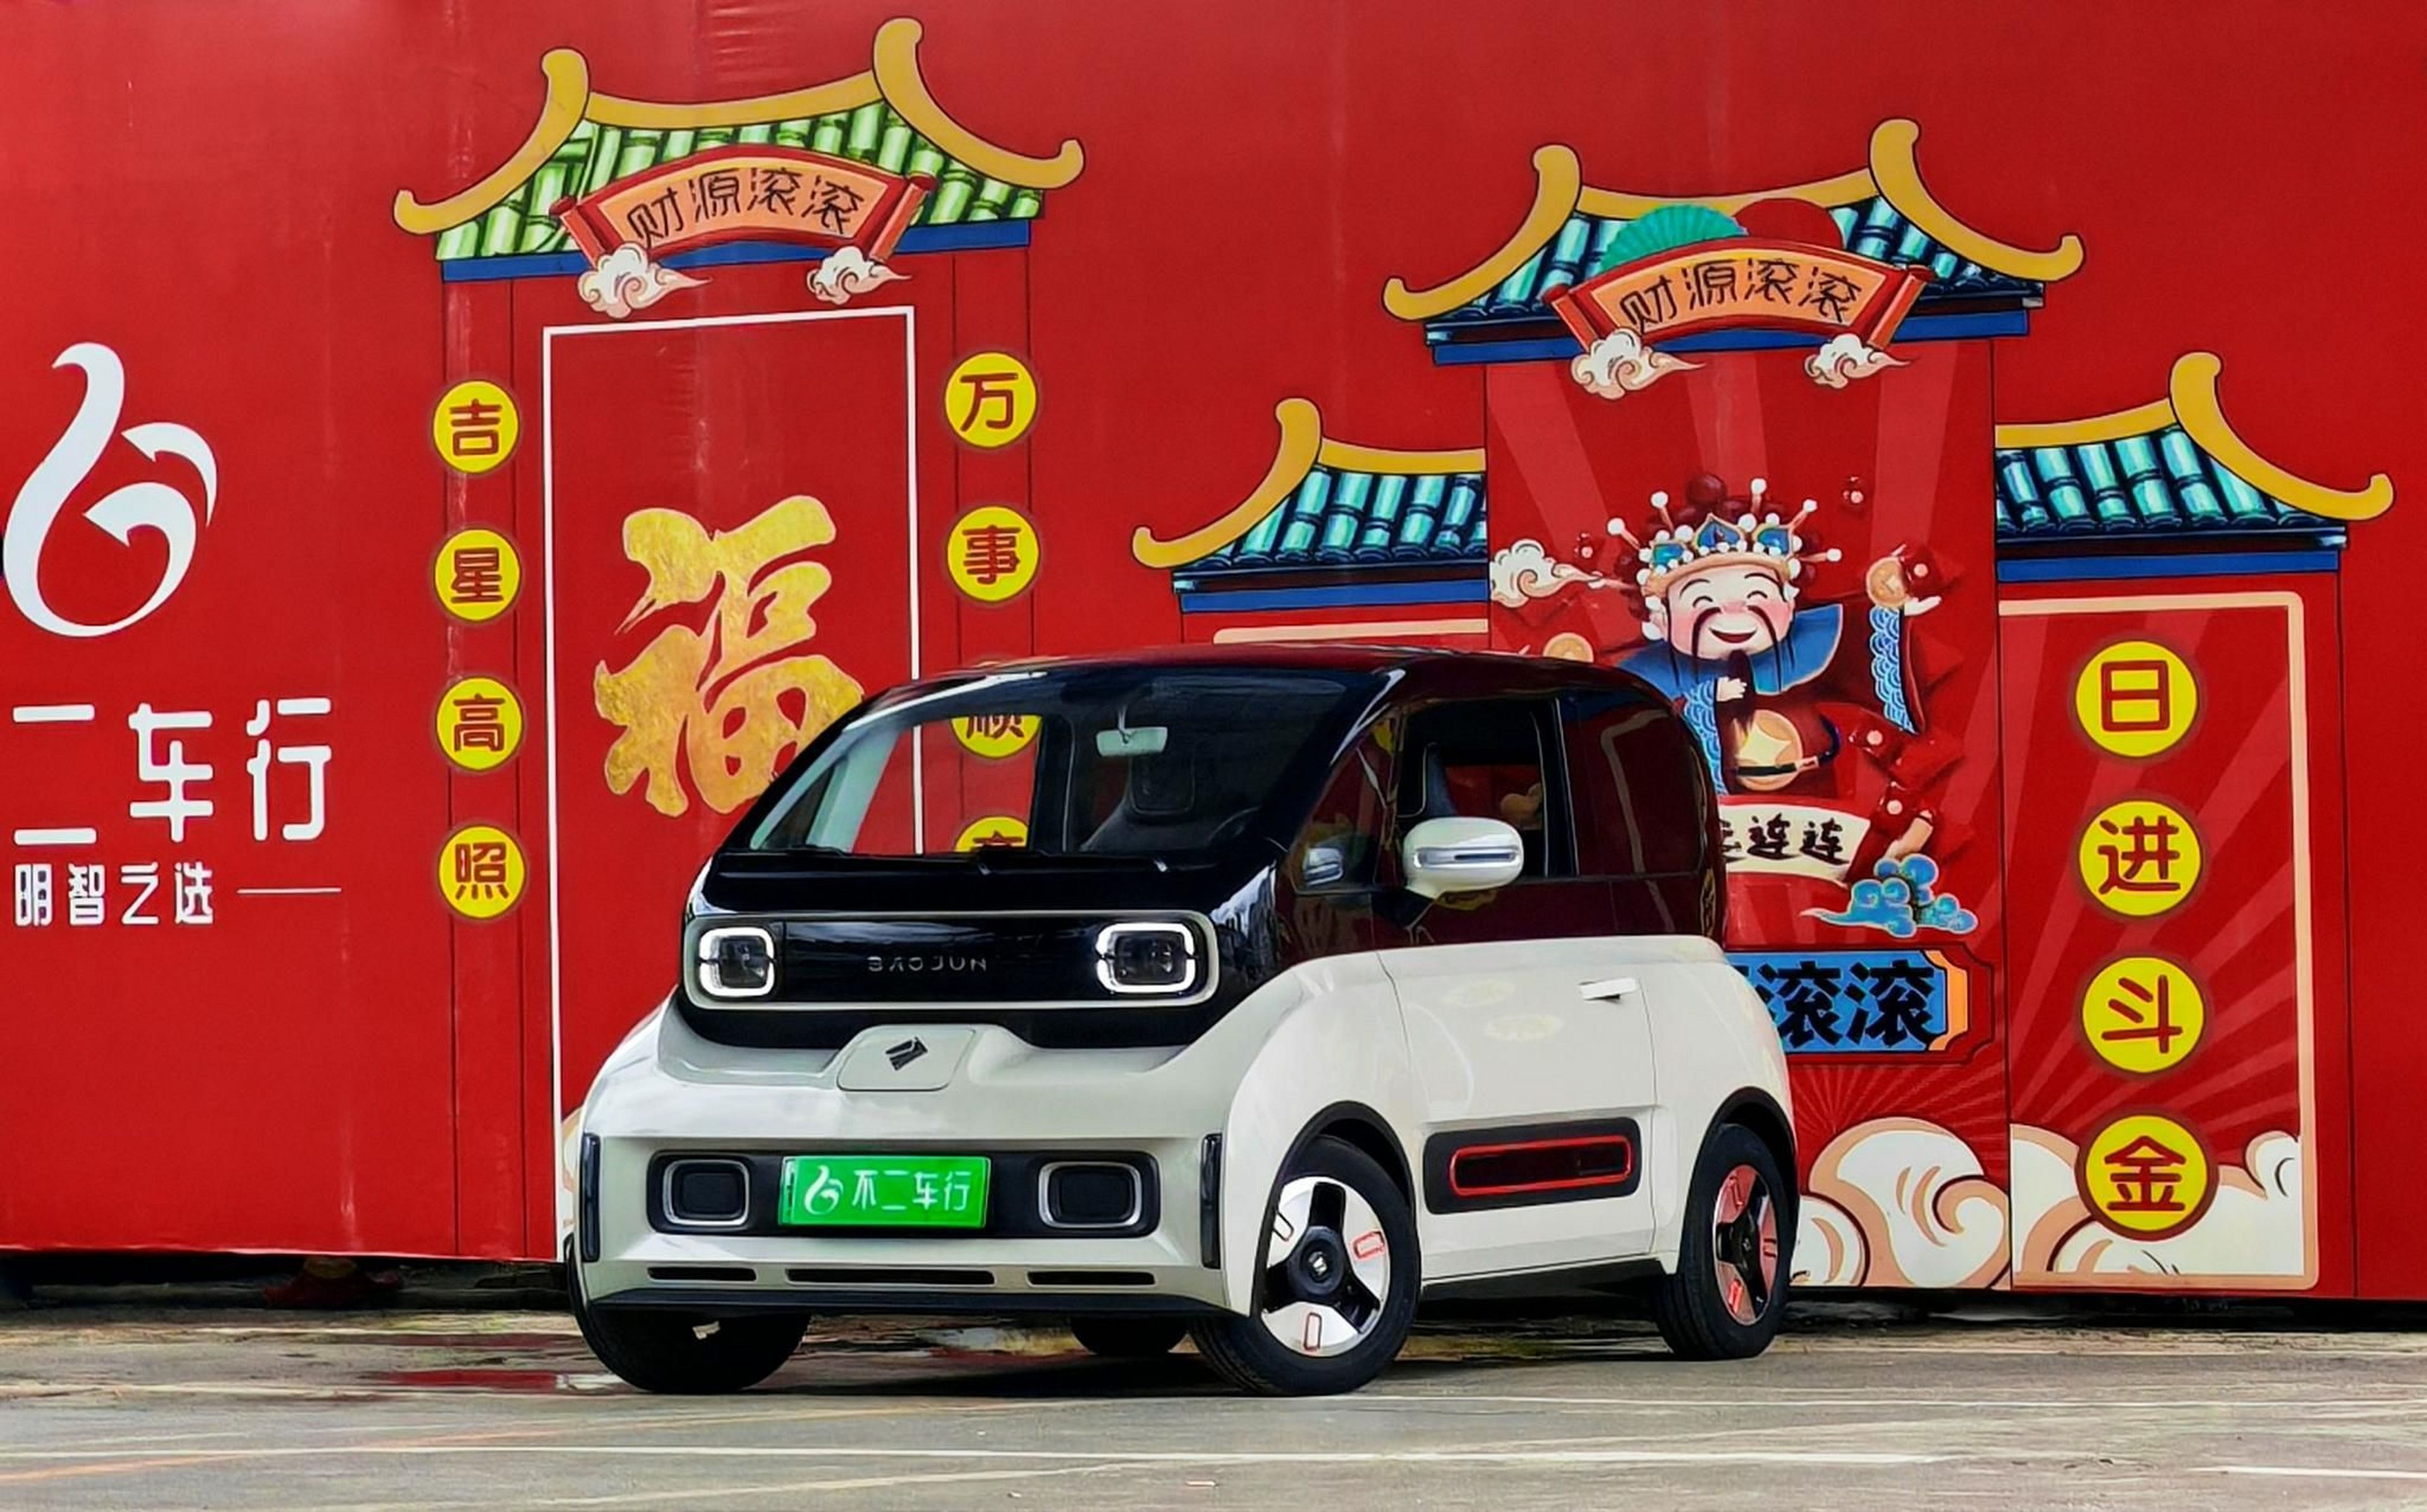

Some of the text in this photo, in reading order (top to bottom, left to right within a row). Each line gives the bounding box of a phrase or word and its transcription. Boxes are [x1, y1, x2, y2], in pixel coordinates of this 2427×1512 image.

[626, 167, 865, 246] 财源滚滚
[1619, 258, 1862, 331] 财源滚滚
[449, 398, 509, 900] 吉星高照
[594, 495, 864, 817] 福
[13, 698, 332, 843] 二车行
[15, 862, 214, 926] 明智之选
[2097, 660, 2187, 1212] 日进斗金
[867, 956, 987, 972] BAOJUN
[1733, 959, 1935, 1048] 滚滚
[851, 1170, 971, 1211] 不二车行
